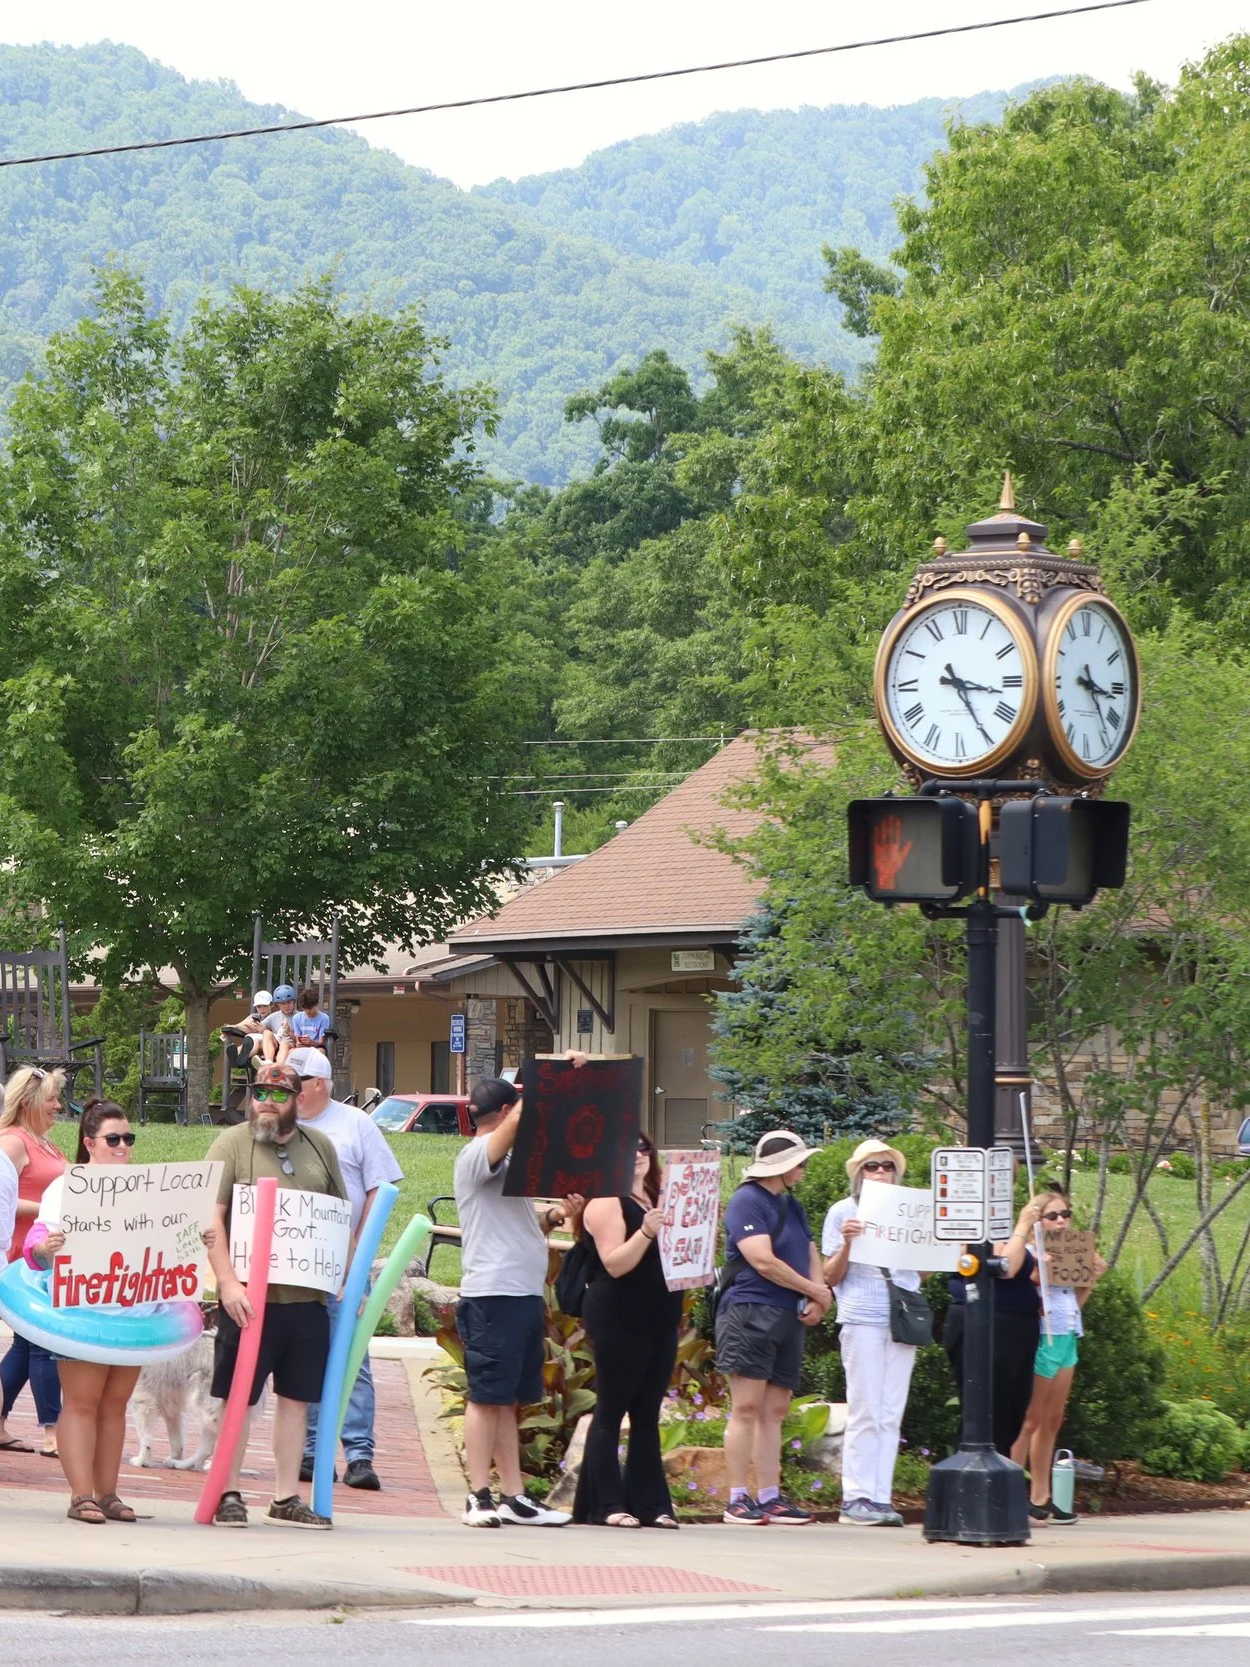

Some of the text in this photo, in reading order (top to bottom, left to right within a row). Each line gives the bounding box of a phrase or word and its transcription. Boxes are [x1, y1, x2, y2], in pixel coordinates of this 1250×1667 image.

[68, 1163, 213, 1207] Support Local
[239, 1190, 291, 1216] Blk
[896, 1202, 932, 1218] SUPP
[61, 1214, 111, 1235] Starts
[162, 1212, 188, 1228] our
[53, 1246, 198, 1308] Firefighters
[233, 1241, 342, 1287] He to Help
[1052, 1265, 1091, 1283] FOOD
